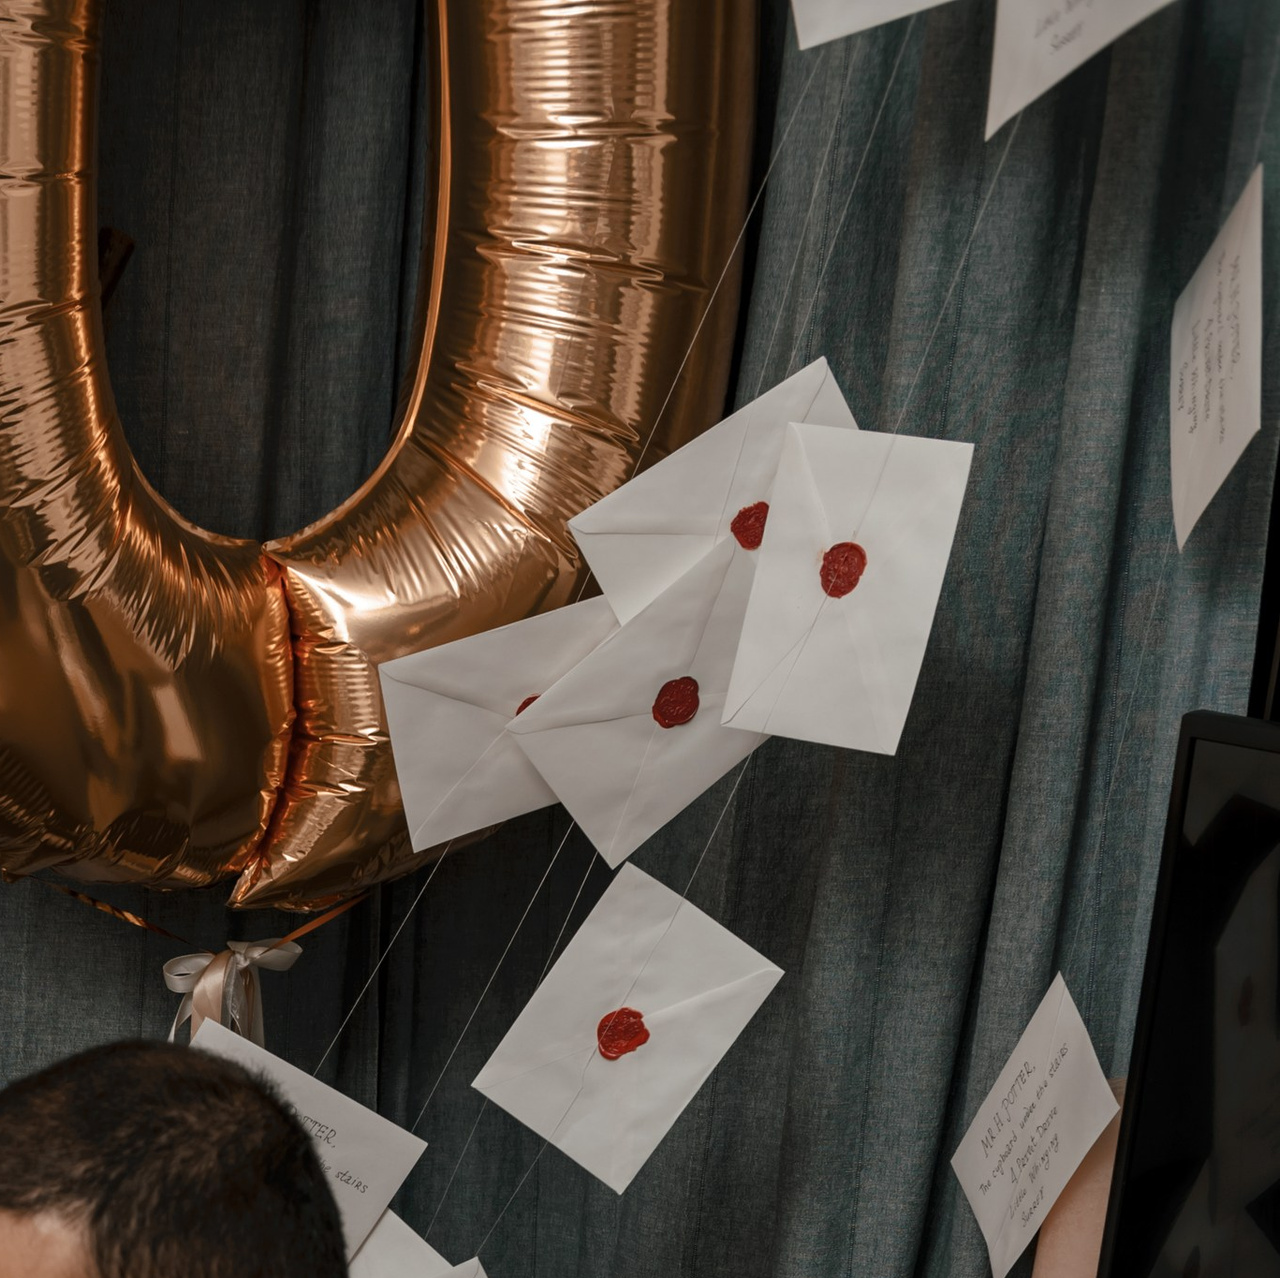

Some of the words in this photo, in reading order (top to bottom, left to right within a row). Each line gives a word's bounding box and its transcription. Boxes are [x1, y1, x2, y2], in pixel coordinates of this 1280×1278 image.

[1001, 1061, 1036, 1123] POTTER,
[979, 1180, 992, 1195] The
[992, 1130, 1018, 1178] cupboard
[1020, 1102, 1036, 1129] under
[1036, 1080, 1048, 1100] the
[1049, 1043, 1069, 1078] stairs
[319, 1157, 332, 1173] he
[335, 1170, 369, 1193] stairs
[1010, 1167, 1018, 1184] 4
